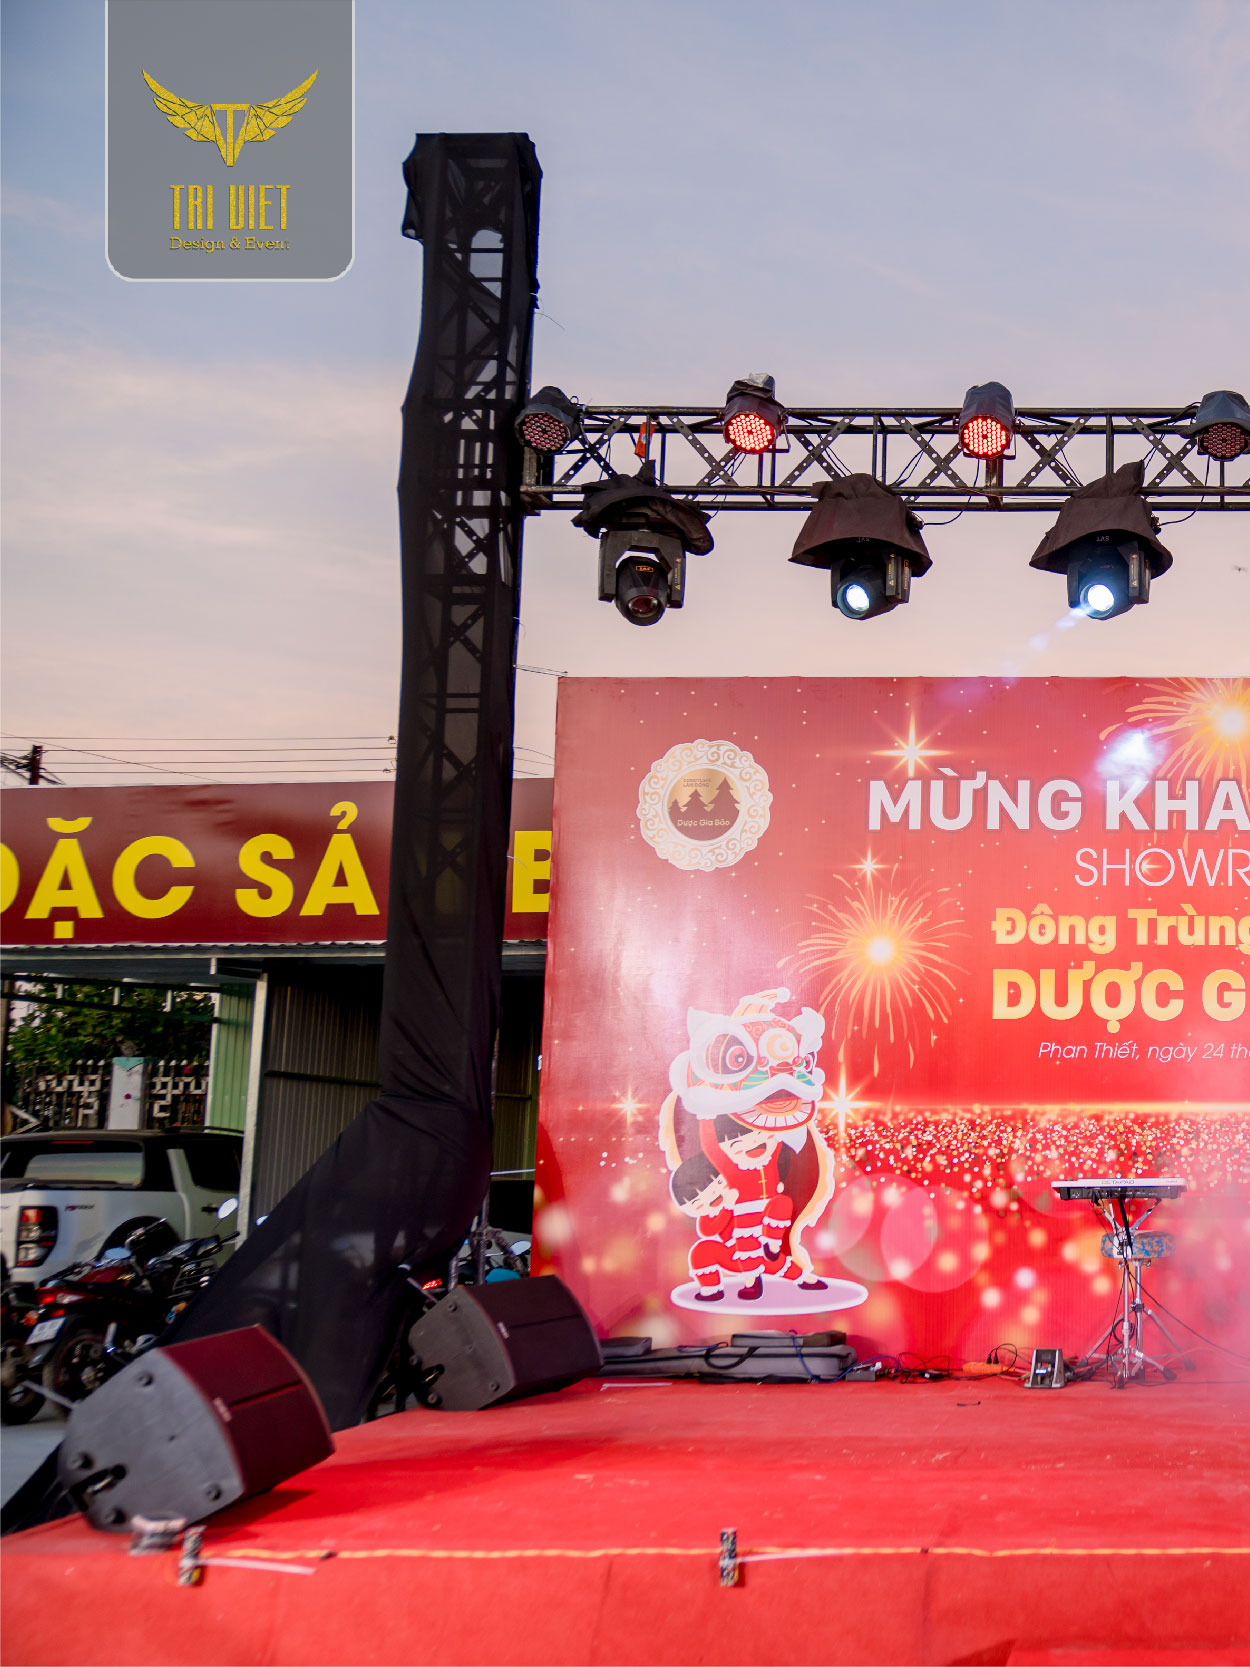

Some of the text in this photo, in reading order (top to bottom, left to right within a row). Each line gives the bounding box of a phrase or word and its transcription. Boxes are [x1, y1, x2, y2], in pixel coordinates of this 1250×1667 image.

[868, 767, 1083, 832] MỪNG
[0, 817, 196, 939] ẶC
[235, 801, 382, 918] SẢ
[991, 903, 1117, 955] Đông
[992, 960, 1185, 1034] DƯỢC
[1037, 1041, 1088, 1059] Phan
[1094, 1040, 1141, 1061] Thiết,
[1147, 1042, 1199, 1064] ngày
[1201, 1043, 1225, 1060] 24
